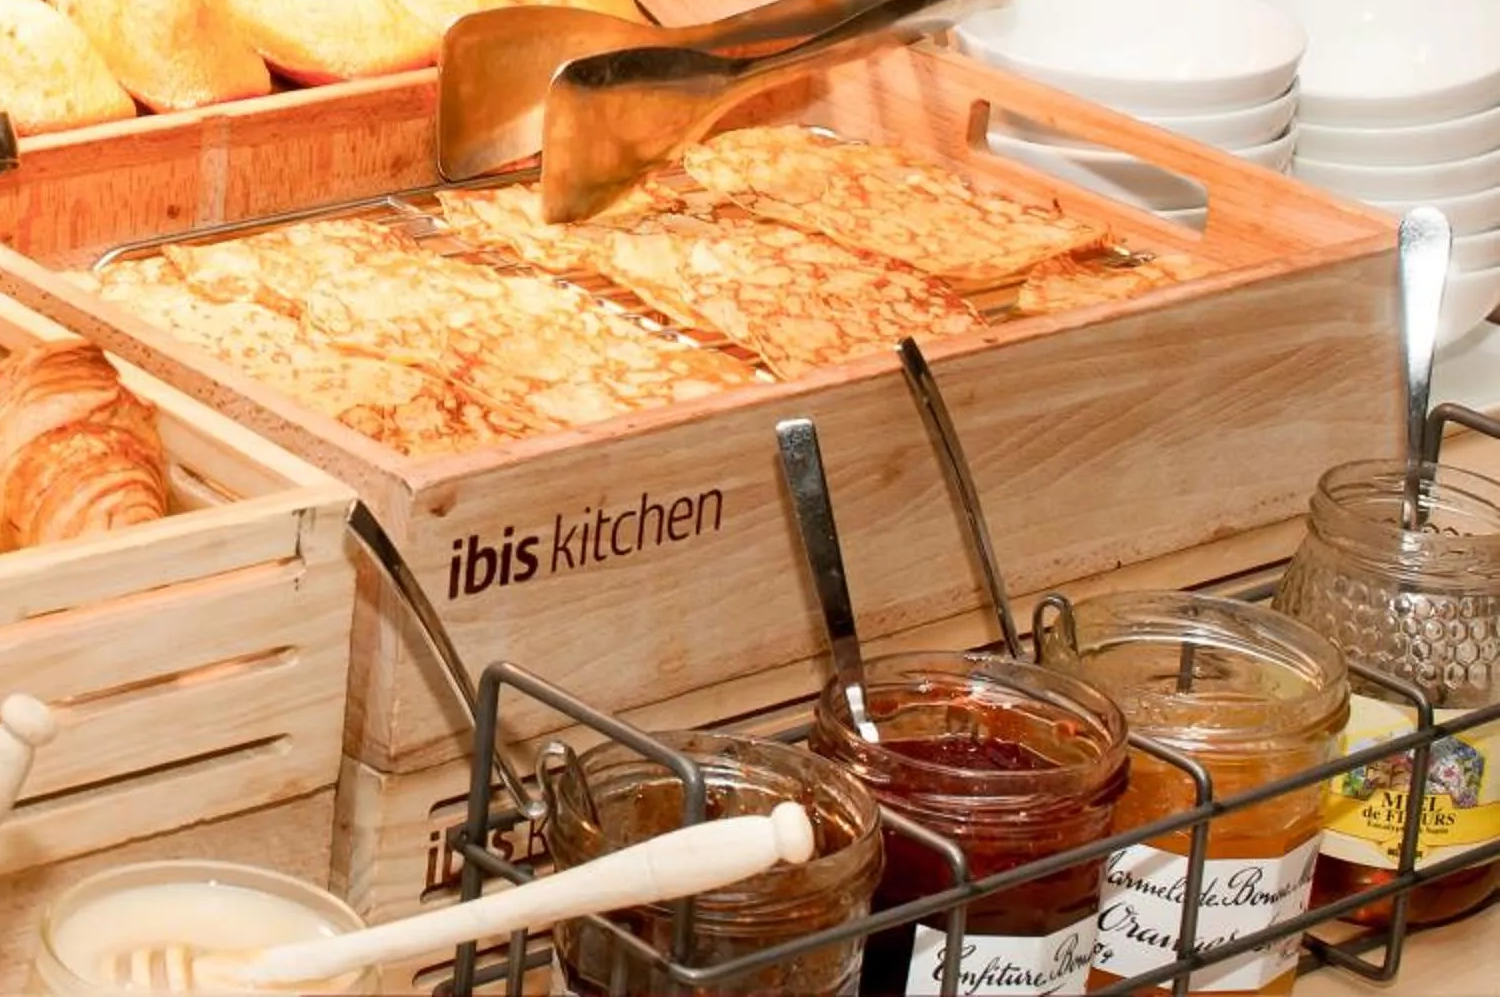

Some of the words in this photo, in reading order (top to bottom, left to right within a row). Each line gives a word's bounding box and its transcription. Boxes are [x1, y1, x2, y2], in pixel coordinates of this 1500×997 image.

[449, 526, 540, 600] ibis
[551, 488, 723, 573] kitchen
[1363, 805, 1381, 819] de
[1386, 809, 1457, 826] FLURS
[1381, 792, 1442, 812] ML
[426, 829, 514, 889] is
[932, 944, 1047, 995] Cnfiture
